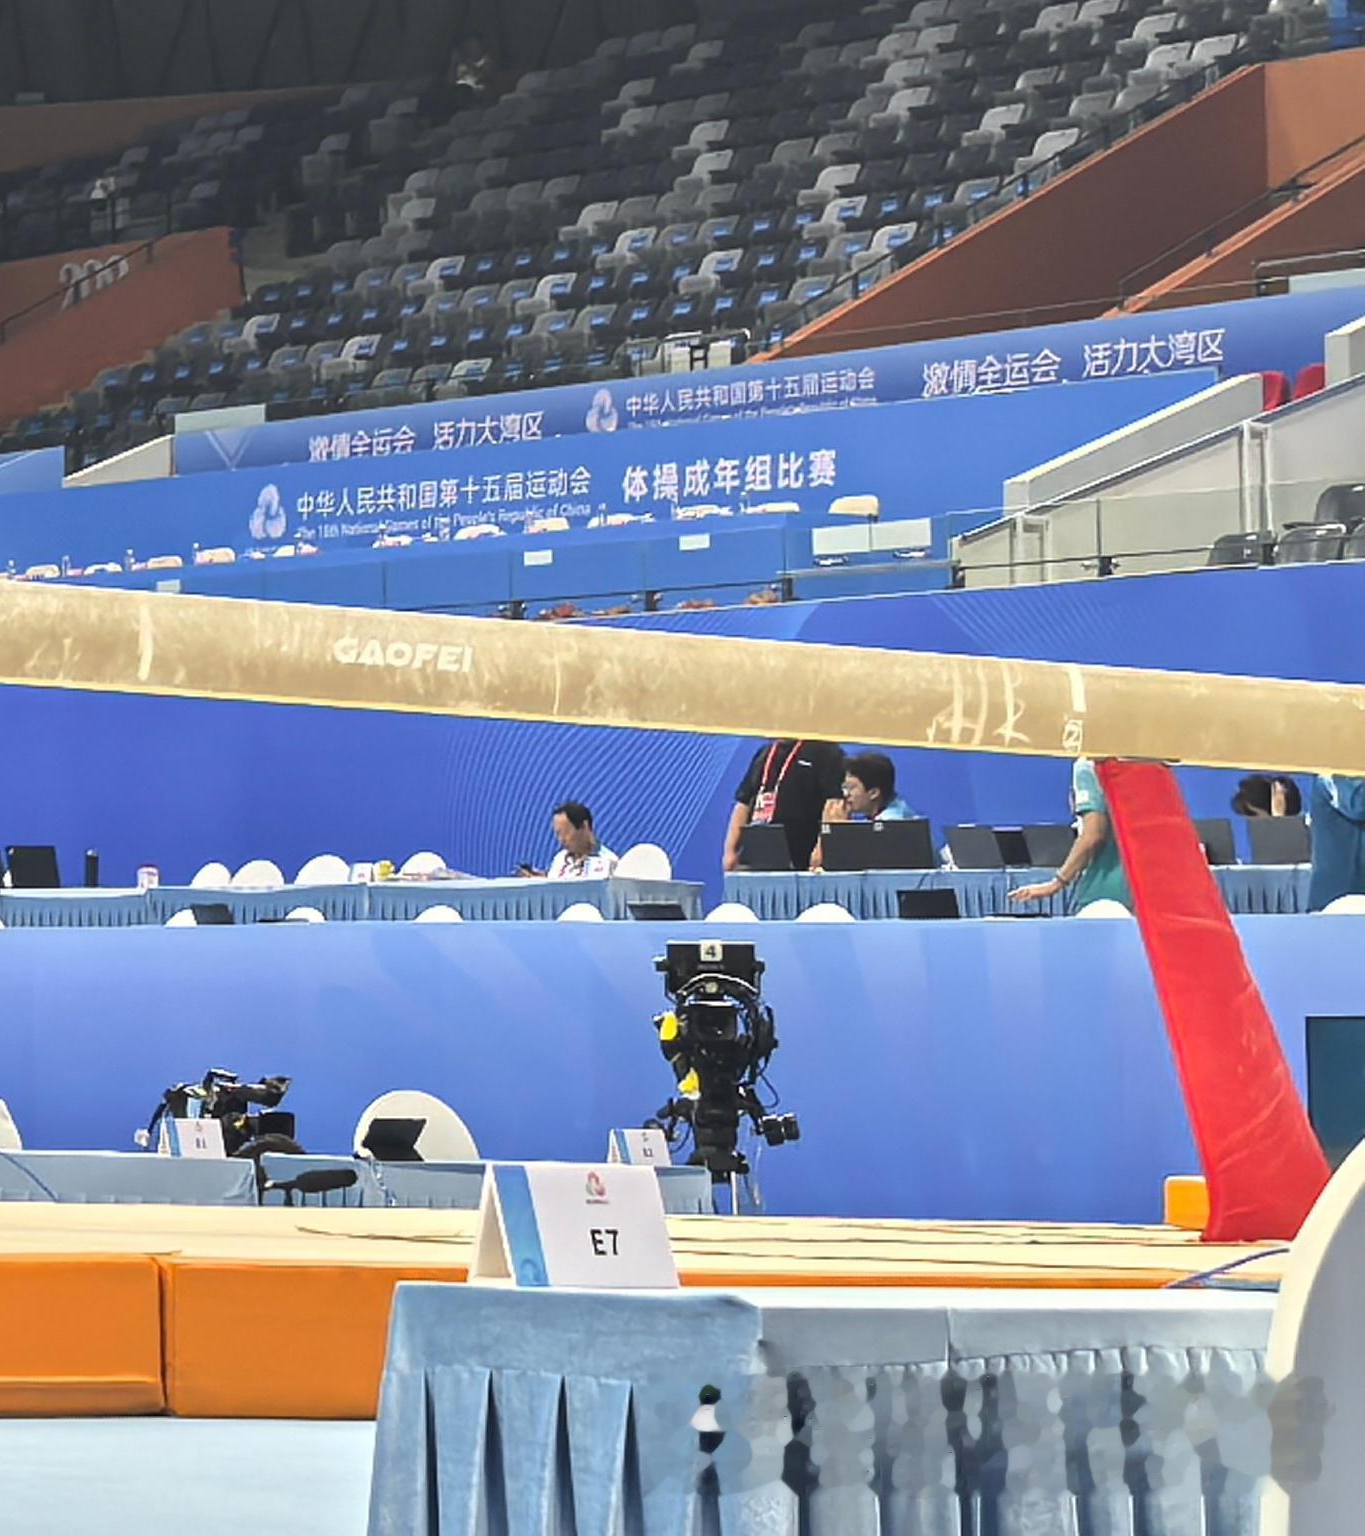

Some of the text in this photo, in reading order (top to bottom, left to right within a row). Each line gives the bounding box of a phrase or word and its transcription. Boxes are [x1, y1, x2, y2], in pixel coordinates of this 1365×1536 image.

[922, 327, 1226, 399] 激情全运会 活力大湾区
[626, 366, 876, 417] 中华人民共和国第十五届运动会
[433, 410, 545, 451] 活力大湾区
[296, 465, 593, 520] 中华人民共和国第十五届运动会
[621, 448, 837, 503] 体操成年组比赛
[333, 637, 474, 673] GAOFEI
[590, 1228, 619, 1256] E7
